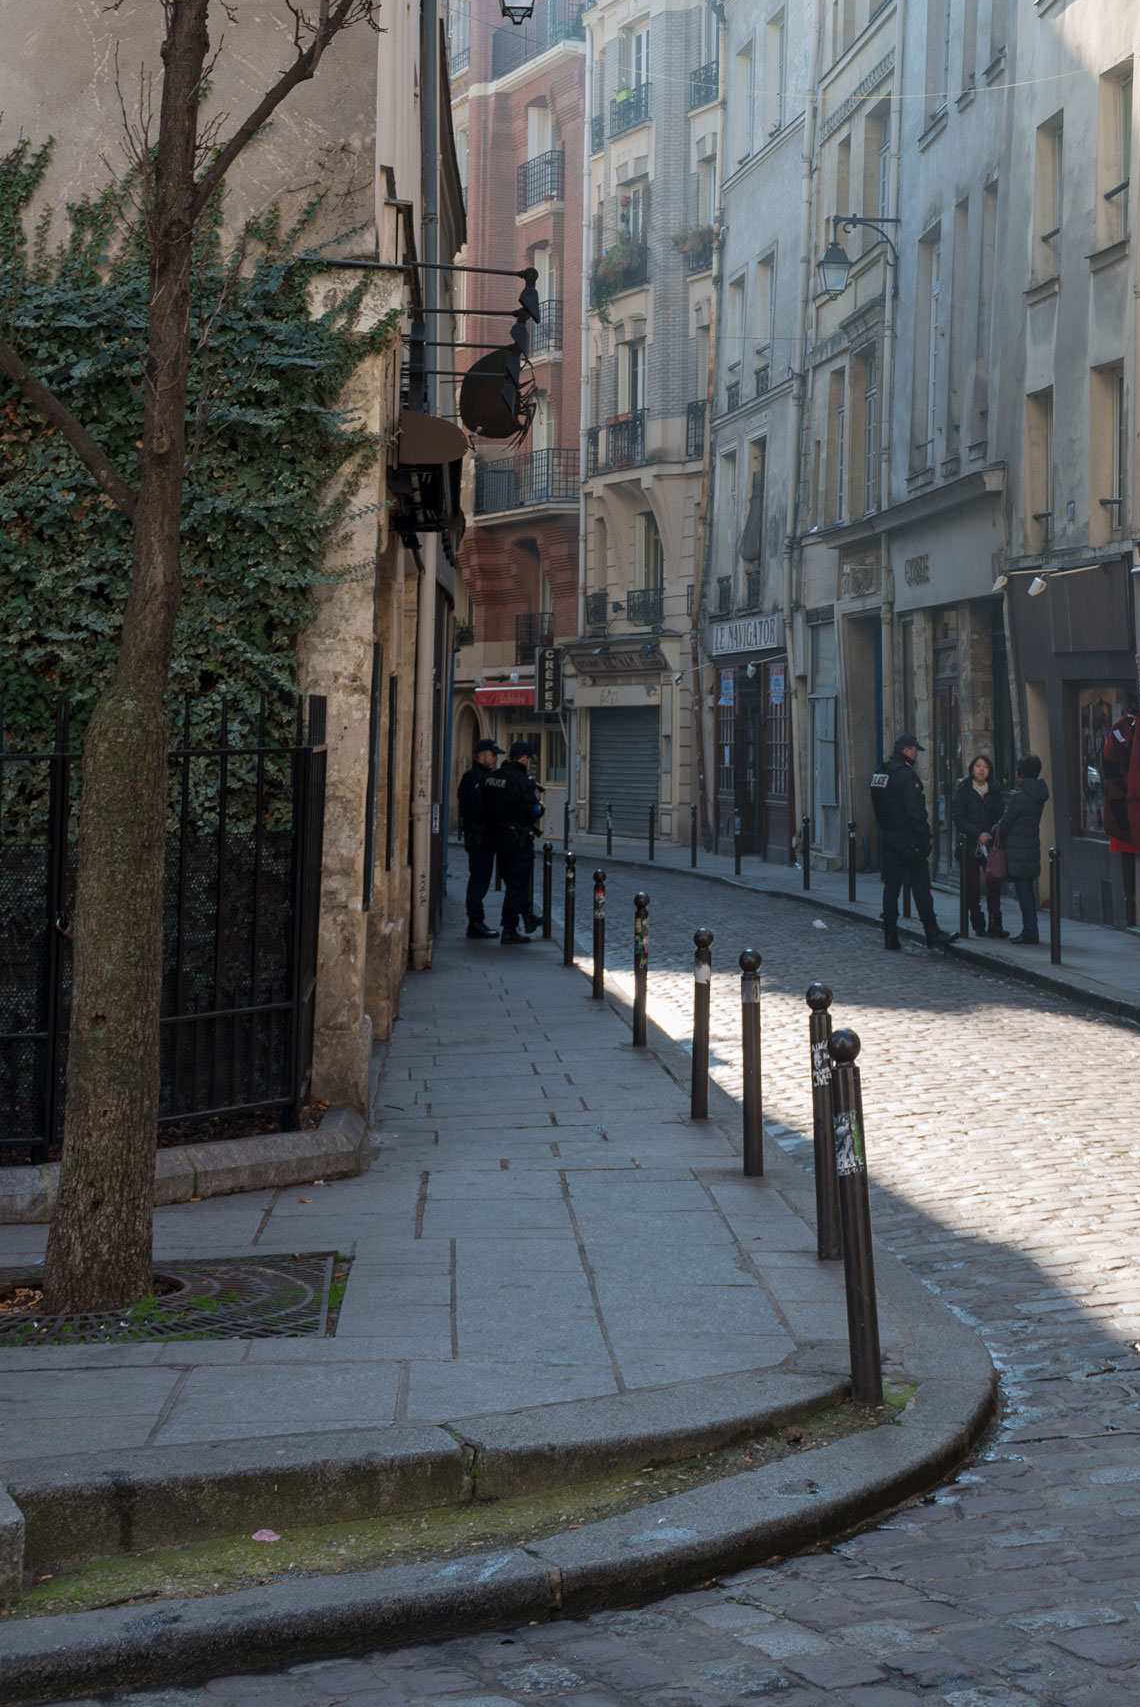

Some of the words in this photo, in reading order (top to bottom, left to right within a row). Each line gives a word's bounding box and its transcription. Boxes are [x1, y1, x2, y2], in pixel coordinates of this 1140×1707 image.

[714, 626, 725, 650] LE
[728, 618, 776, 648] NAVIGATOR
[485, 777, 507, 788] POLICE
